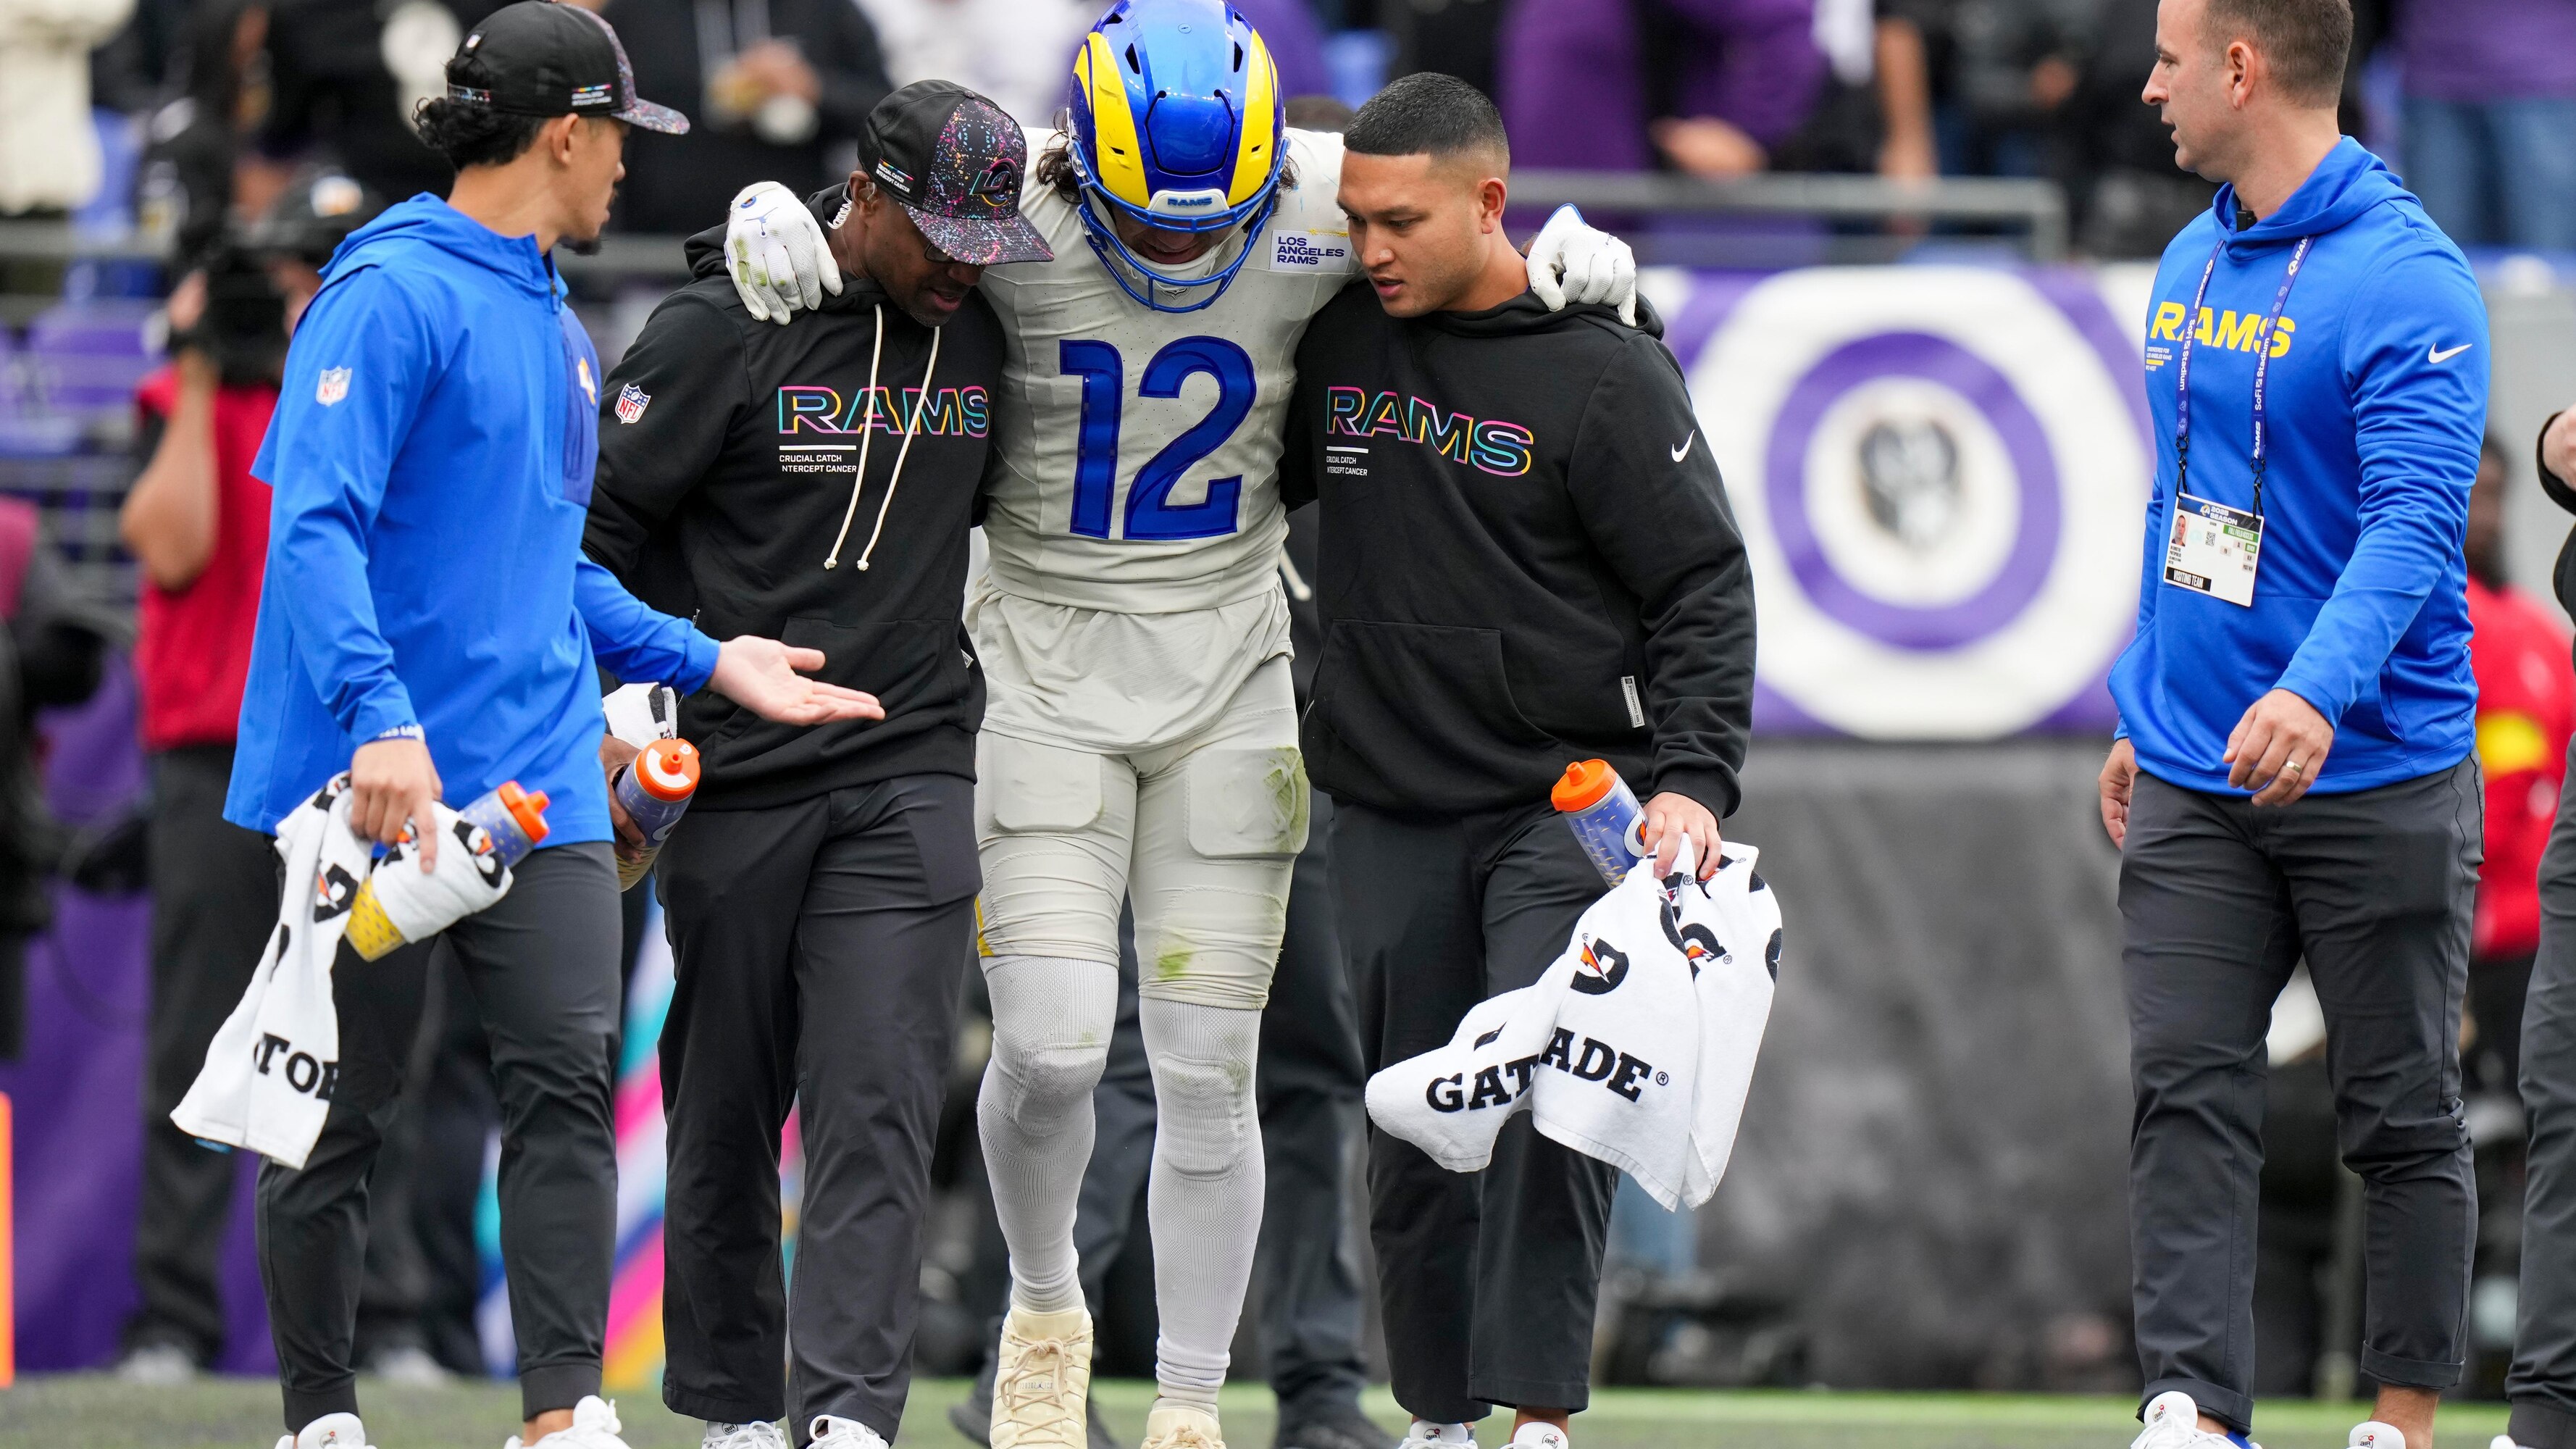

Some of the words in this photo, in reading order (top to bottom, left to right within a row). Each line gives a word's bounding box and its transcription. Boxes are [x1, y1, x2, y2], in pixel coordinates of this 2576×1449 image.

[1167, 196, 1213, 206] RAMS
[1277, 246, 1345, 257] ANGELES
[1278, 236, 1307, 246] LOS
[2295, 235, 2309, 261] RAM
[1277, 255, 1319, 265] RAMS
[2150, 301, 2296, 358] RAMS
[2186, 319, 2196, 340] SoFi
[2257, 338, 2270, 377] Stadium
[2179, 351, 2189, 391] Stadium
[619, 398, 639, 419] NFL
[778, 385, 989, 438] RAMS
[1059, 335, 1257, 540] 12
[1326, 386, 1534, 477] RAMS
[1345, 467, 1368, 476] CANCER
[2210, 512, 2238, 526] SEASON
[2173, 569, 2192, 584] VISITING
[2191, 575, 2204, 588] TEAM
